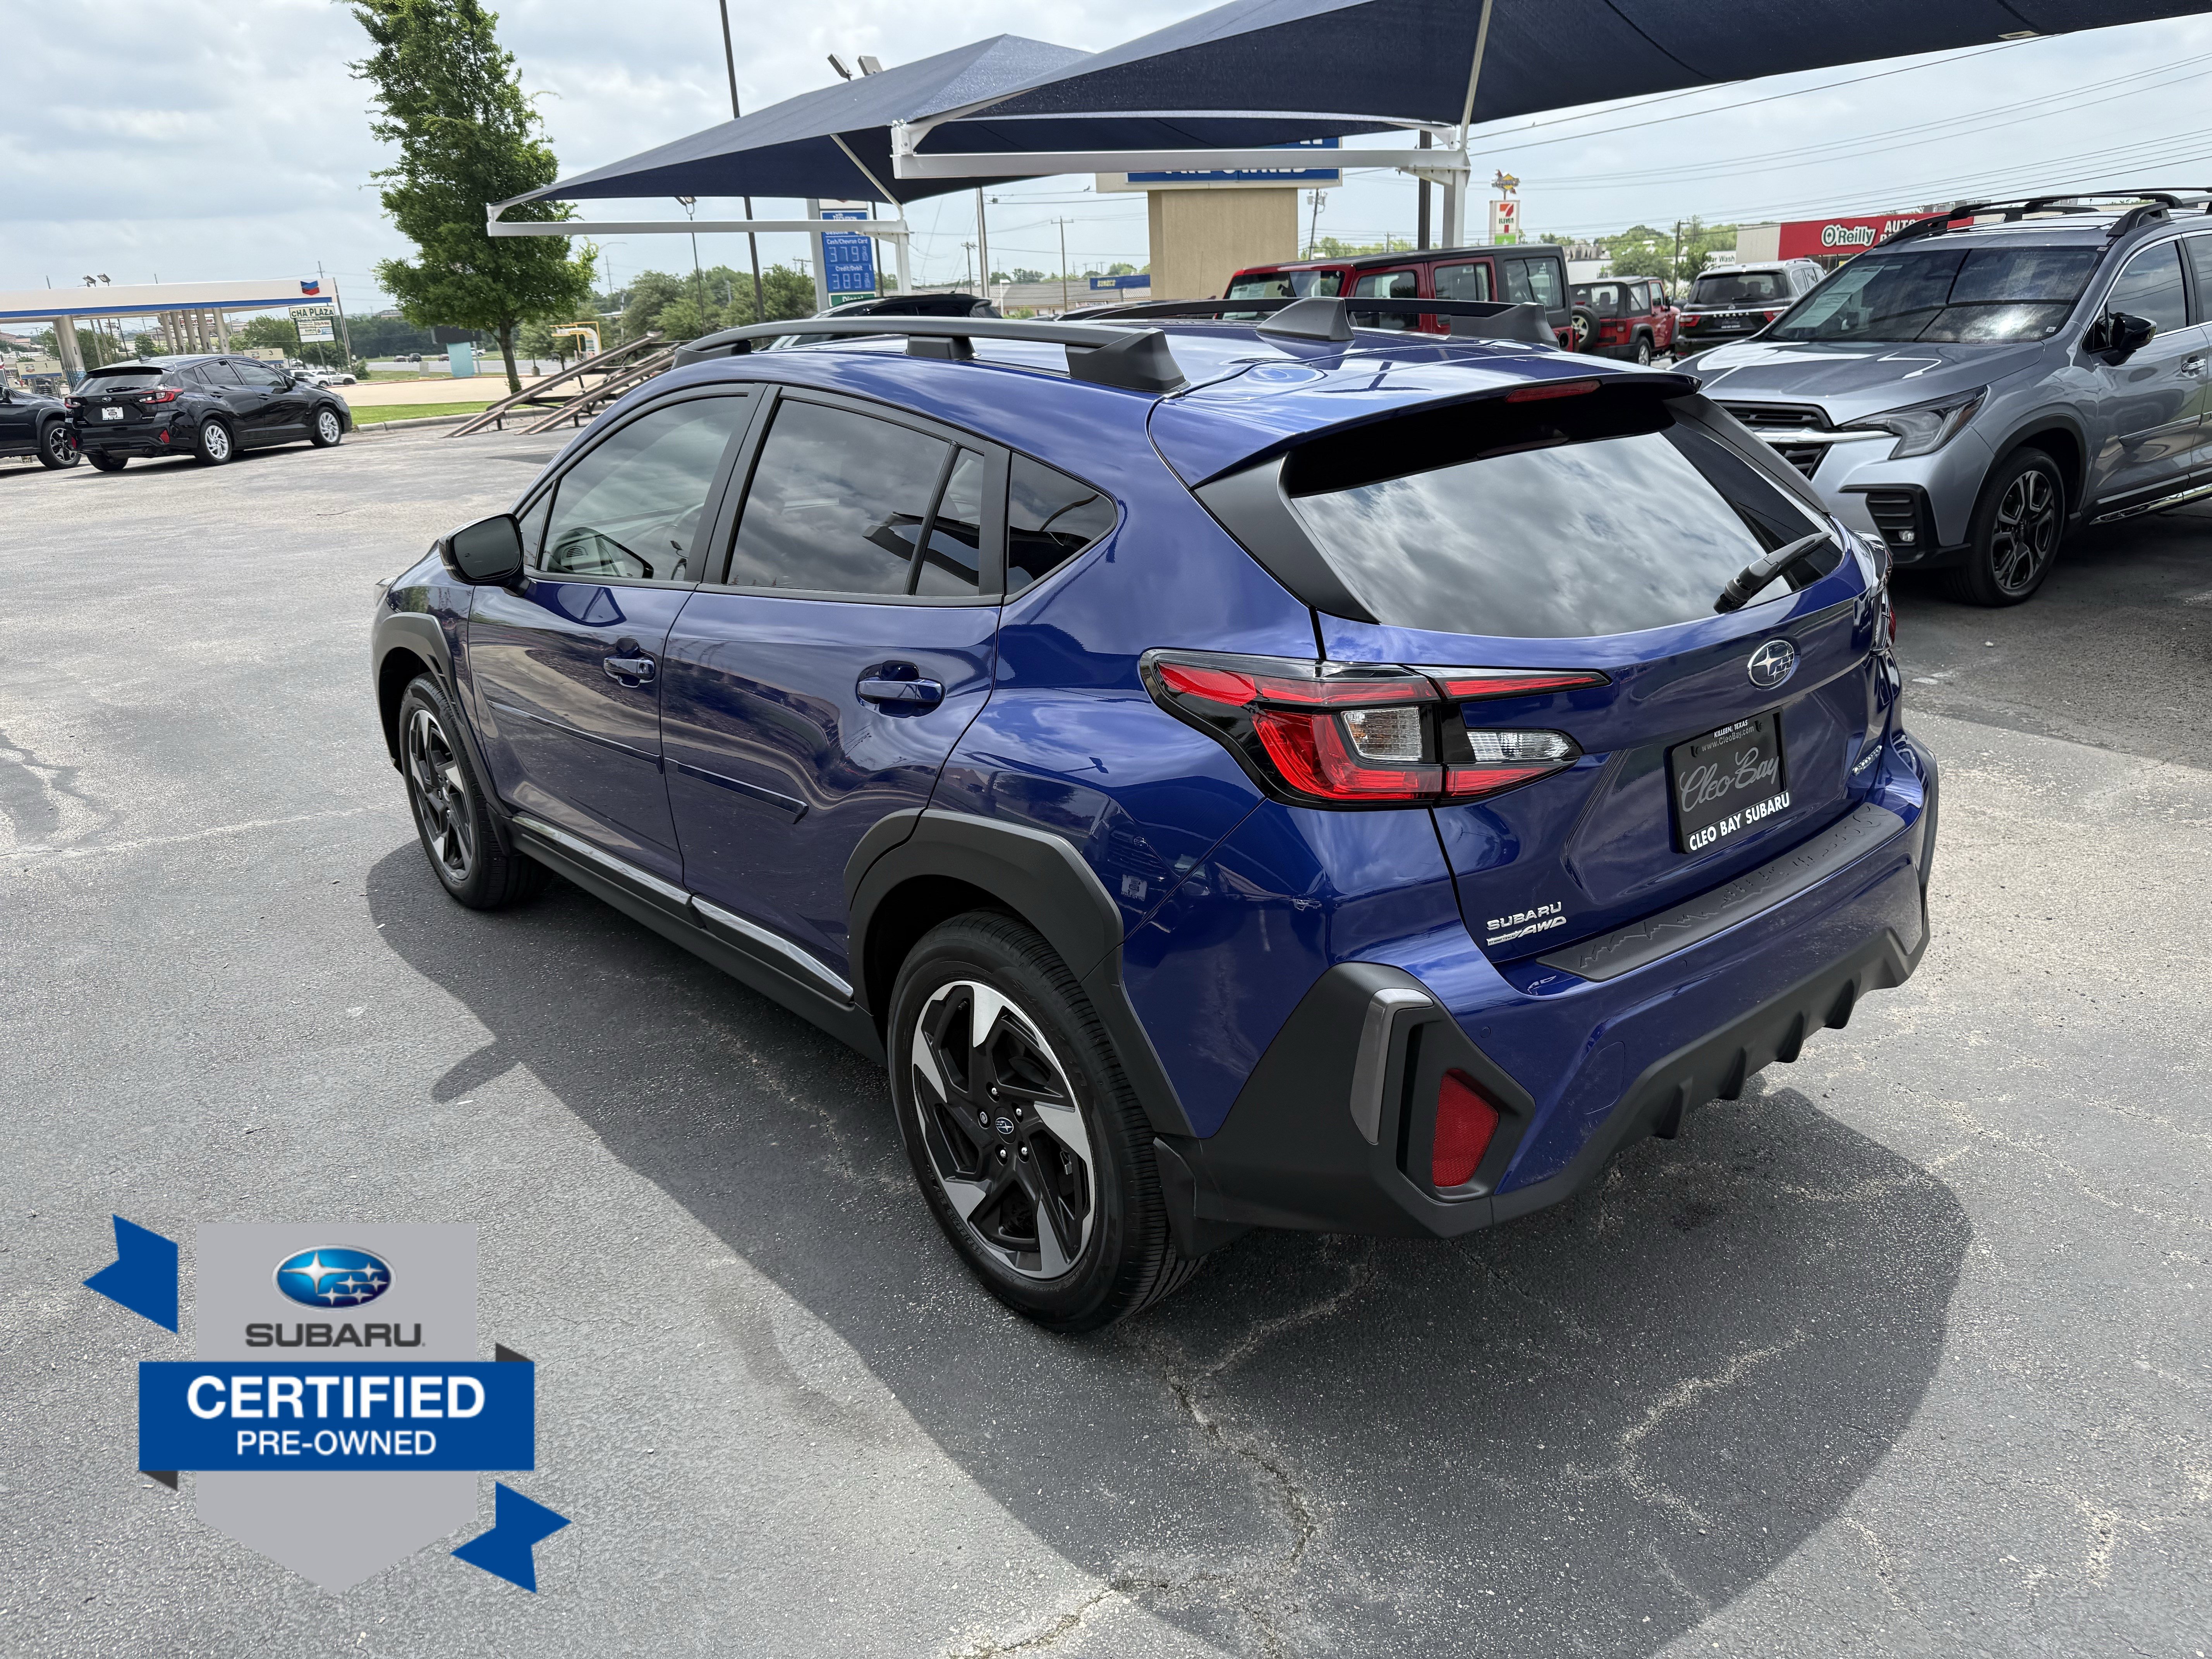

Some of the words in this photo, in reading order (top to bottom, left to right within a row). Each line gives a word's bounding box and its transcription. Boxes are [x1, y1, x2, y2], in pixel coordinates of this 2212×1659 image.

[1822, 225, 1875, 246] O'Reilly
[829, 246, 859, 262] 379
[832, 273, 862, 289] 389
[309, 308, 334, 316] PLAZA
[1702, 726, 1754, 752] www.CleoBay.com
[1714, 726, 1733, 738] KILLEEN,
[1734, 719, 1748, 731] TEXAS
[1679, 763, 1735, 812] Cleo
[1735, 747, 1779, 789] Bay
[1689, 826, 1717, 851] CLEO
[1719, 813, 1741, 836] BAY
[1745, 792, 1790, 824] SUBARU
[1486, 901, 1562, 931] SUBARU
[1518, 916, 1567, 938] AWD
